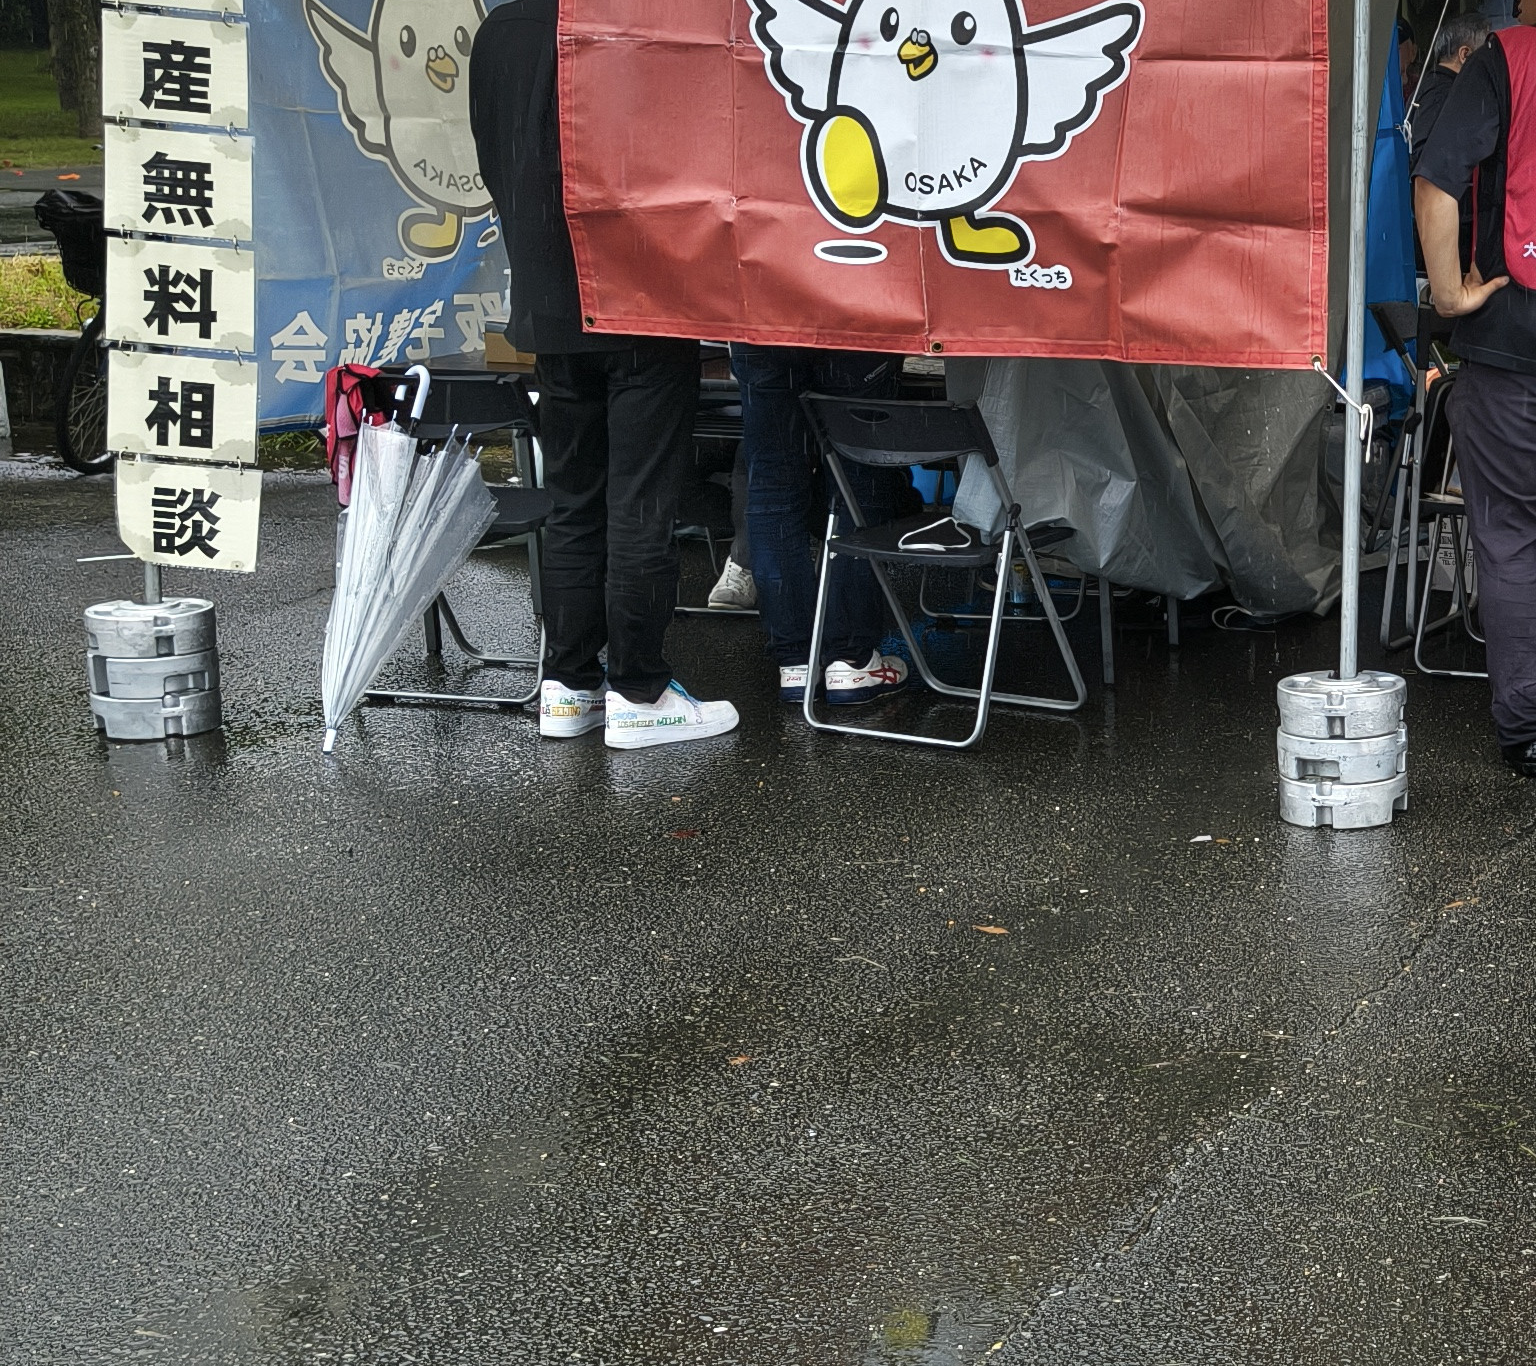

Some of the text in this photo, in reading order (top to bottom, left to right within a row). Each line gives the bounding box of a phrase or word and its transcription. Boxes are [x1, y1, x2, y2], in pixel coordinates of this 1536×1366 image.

[904, 157, 988, 195] OSAKA
[1013, 267, 1068, 284] たくっち
